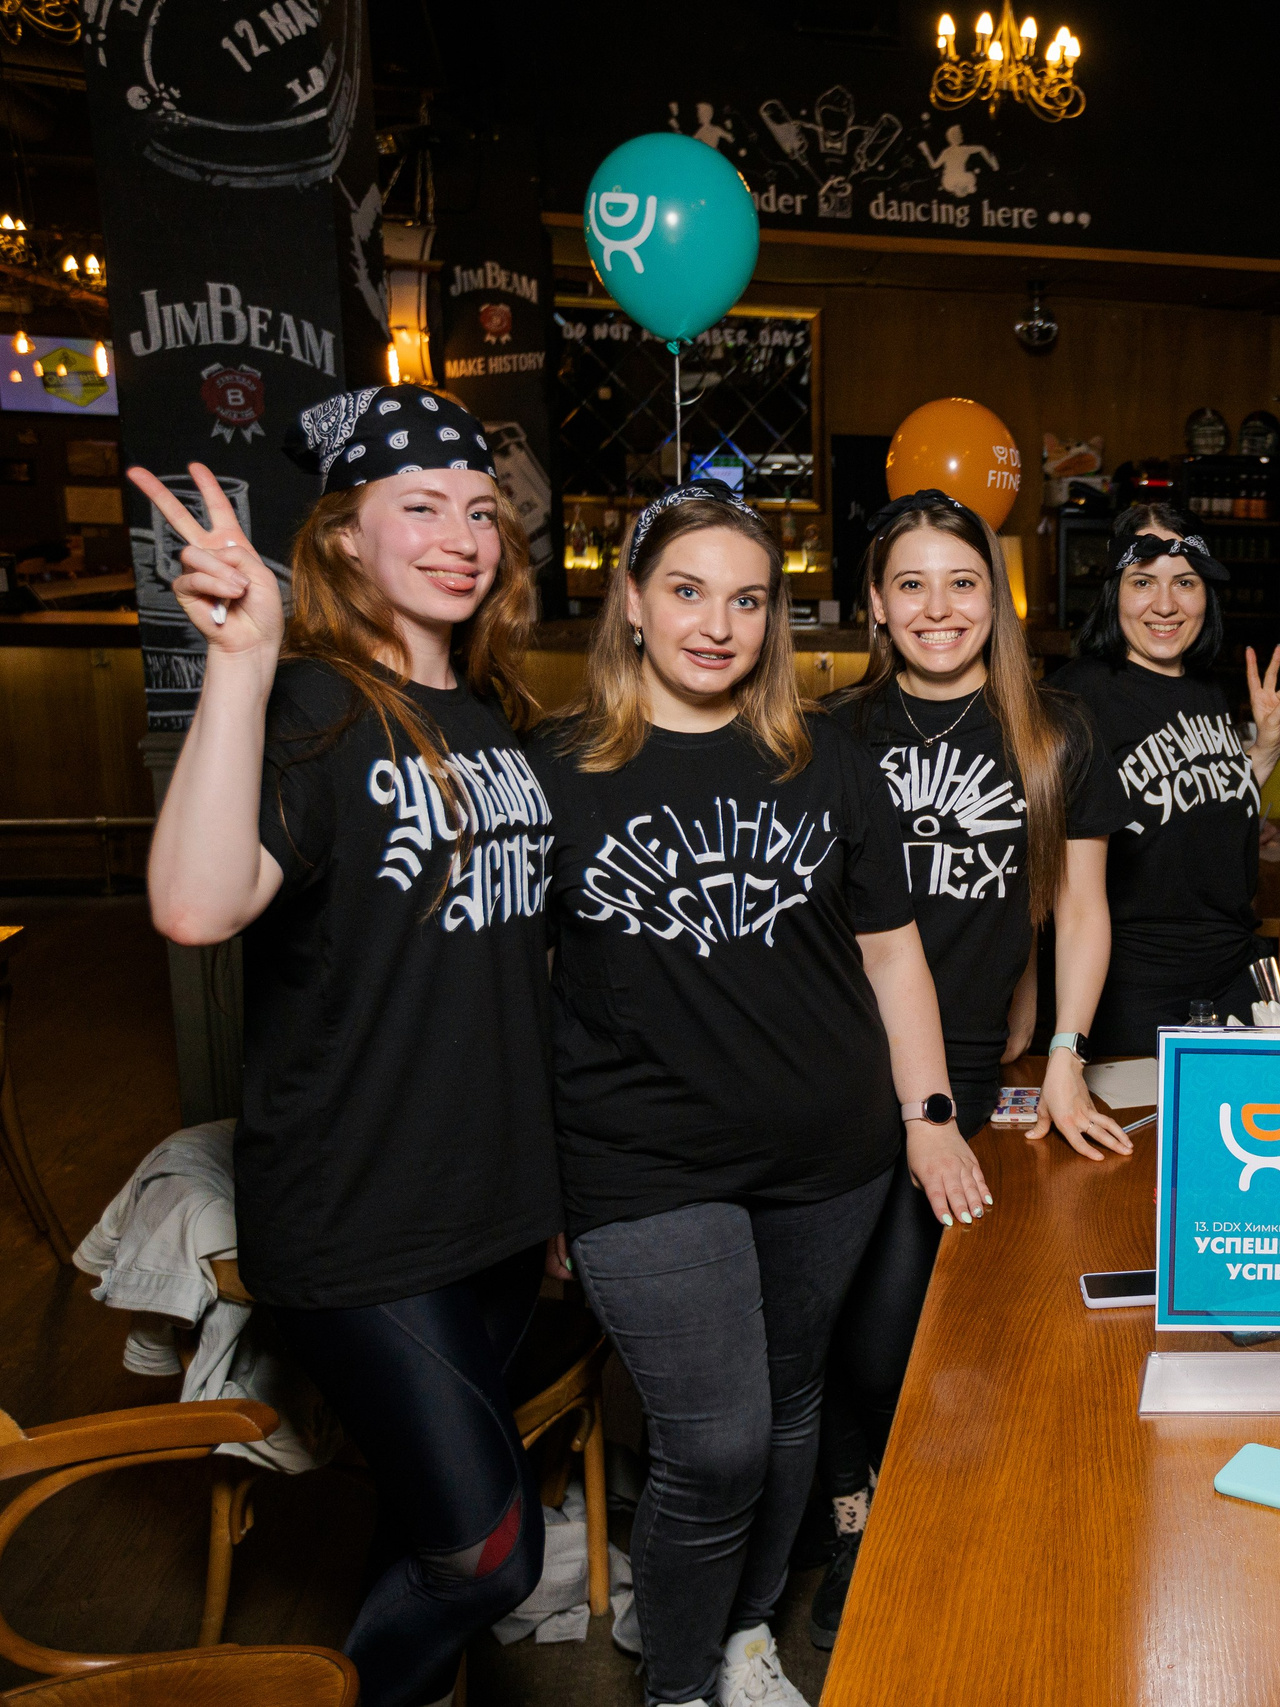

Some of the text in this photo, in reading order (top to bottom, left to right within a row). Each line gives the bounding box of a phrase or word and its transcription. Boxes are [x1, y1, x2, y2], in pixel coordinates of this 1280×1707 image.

[221, 19, 271, 73] 12
[869, 192, 970, 228] dancing
[982, 200, 1039, 230] here
[445, 351, 546, 379] MAKE HISTORY
[1144, 760, 1260, 825] УСПЕХ
[577, 796, 838, 935] УСПЕШНЫЙ
[903, 842, 1017, 900] ПЕХ
[643, 872, 809, 958] УСПЕХ
[1194, 1221, 1209, 1232] 13.
[1212, 1221, 1242, 1232] DDX
